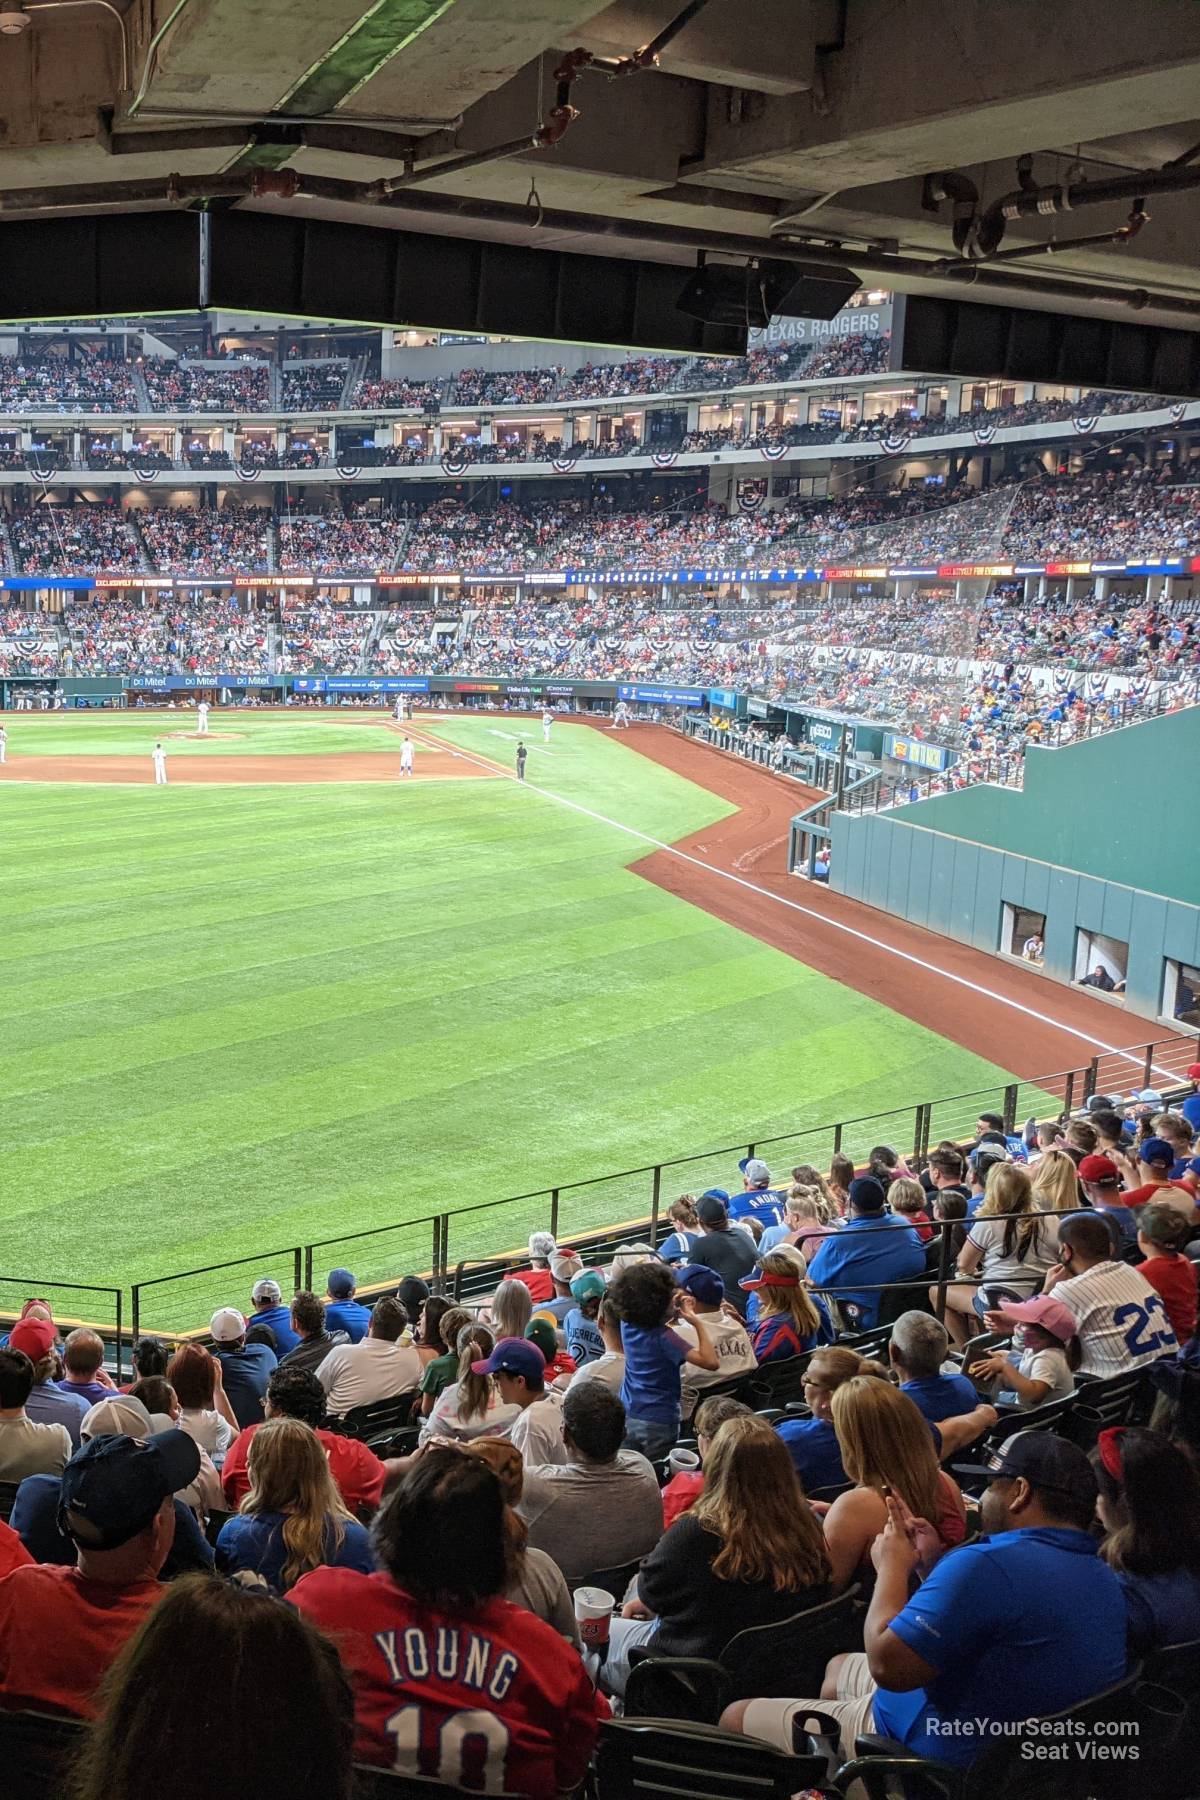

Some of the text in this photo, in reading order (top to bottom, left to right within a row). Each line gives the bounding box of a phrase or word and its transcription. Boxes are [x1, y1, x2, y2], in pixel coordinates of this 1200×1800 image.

[762, 321, 805, 341] TEXAS
[811, 313, 879, 337] RANGERS
[145, 677, 167, 686] Mitel
[196, 676, 218, 685] Mitel
[248, 676, 270, 685] Mitel
[816, 724, 832, 739] GEICO
[375, 1627, 518, 1700] YOUNG
[385, 1705, 509, 1792] 10
